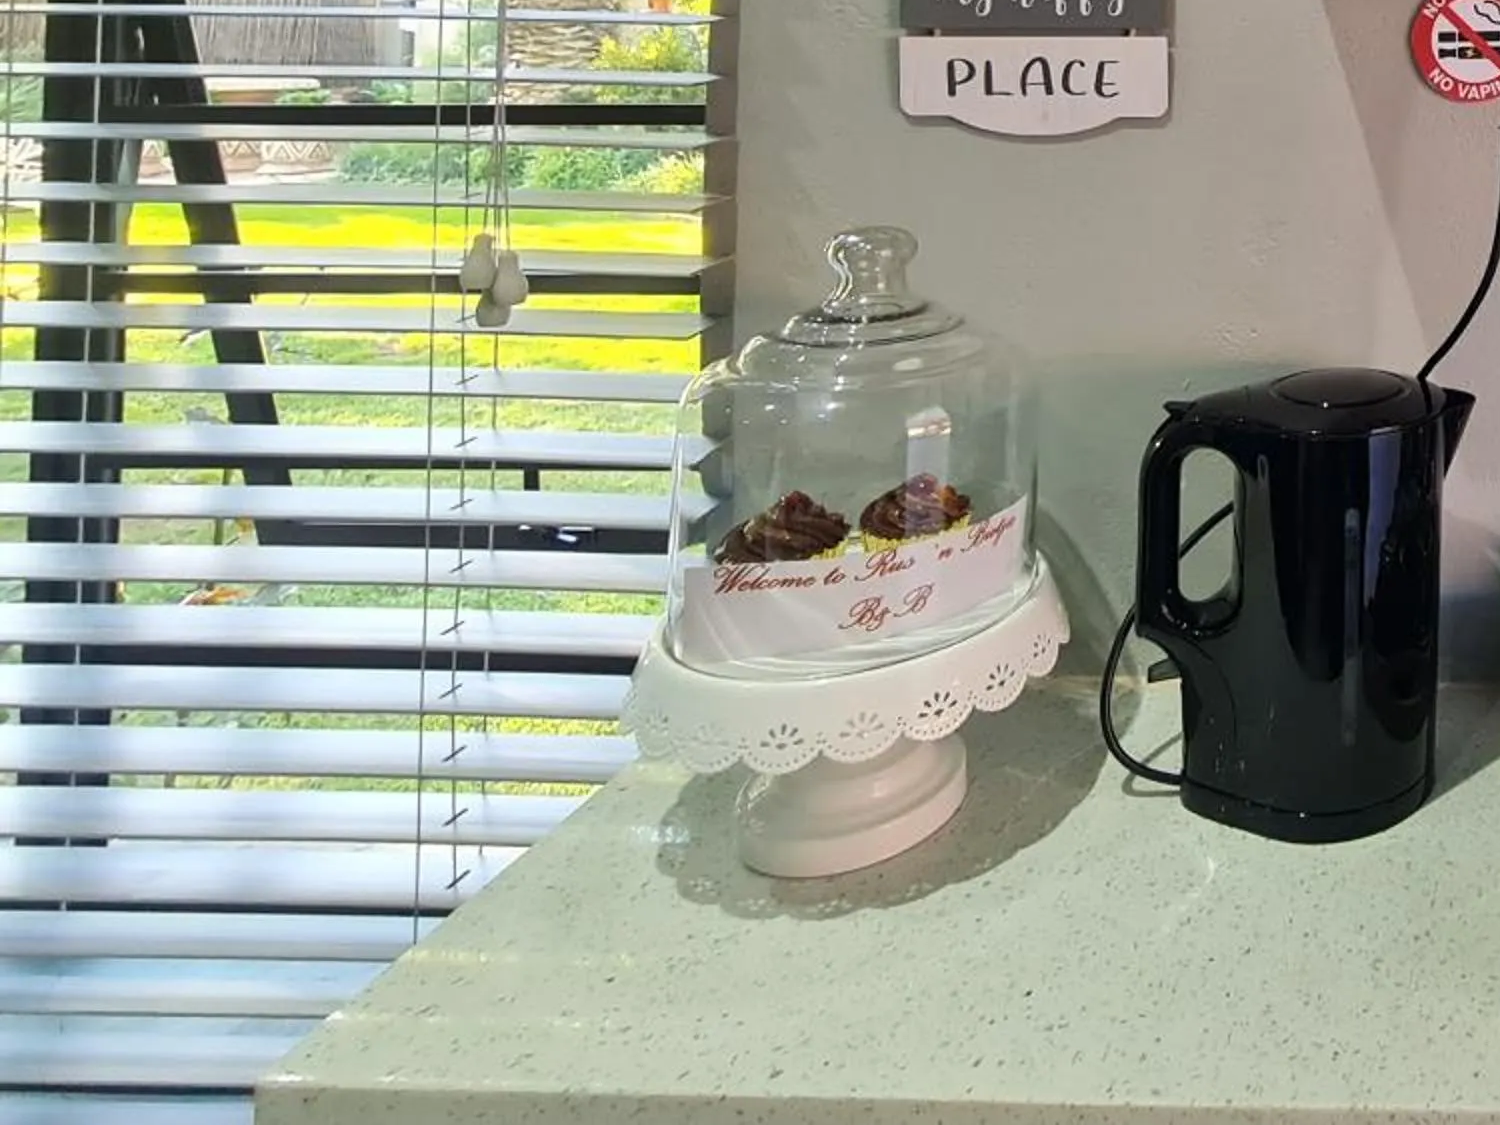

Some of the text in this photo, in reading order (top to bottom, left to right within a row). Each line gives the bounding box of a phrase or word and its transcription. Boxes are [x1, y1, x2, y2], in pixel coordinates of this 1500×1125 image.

[946, 56, 1120, 98] PLACE
[1429, 68, 1453, 92] NO
[713, 562, 816, 594] Welcome
[823, 567, 846, 585] to
